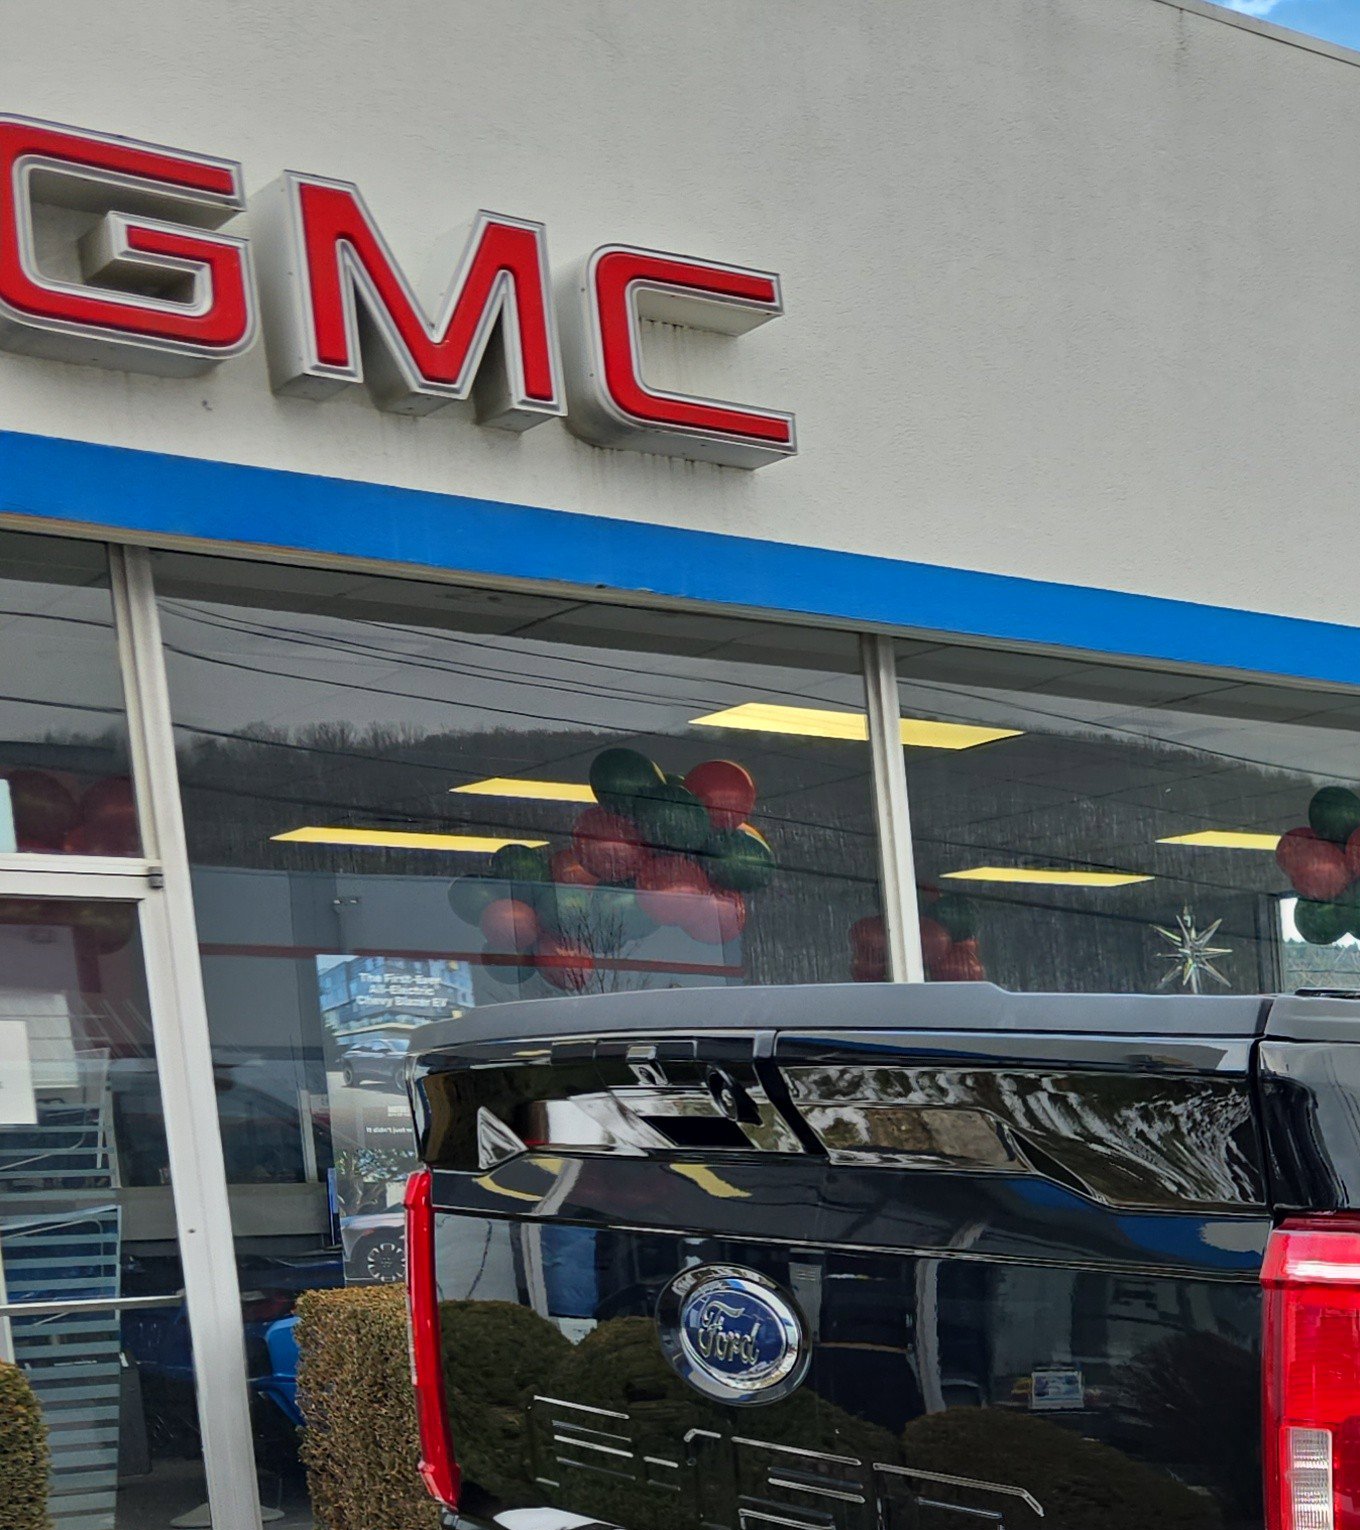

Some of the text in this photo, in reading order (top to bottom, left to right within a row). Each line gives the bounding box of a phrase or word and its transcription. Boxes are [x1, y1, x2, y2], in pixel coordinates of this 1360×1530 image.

[0, 112, 798, 469] GMC
[358, 973, 383, 983] The
[368, 984, 435, 995] All-Electric
[355, 995, 393, 1007] Chevy
[432, 997, 449, 1007] EV
[697, 1299, 762, 1366] Ford
